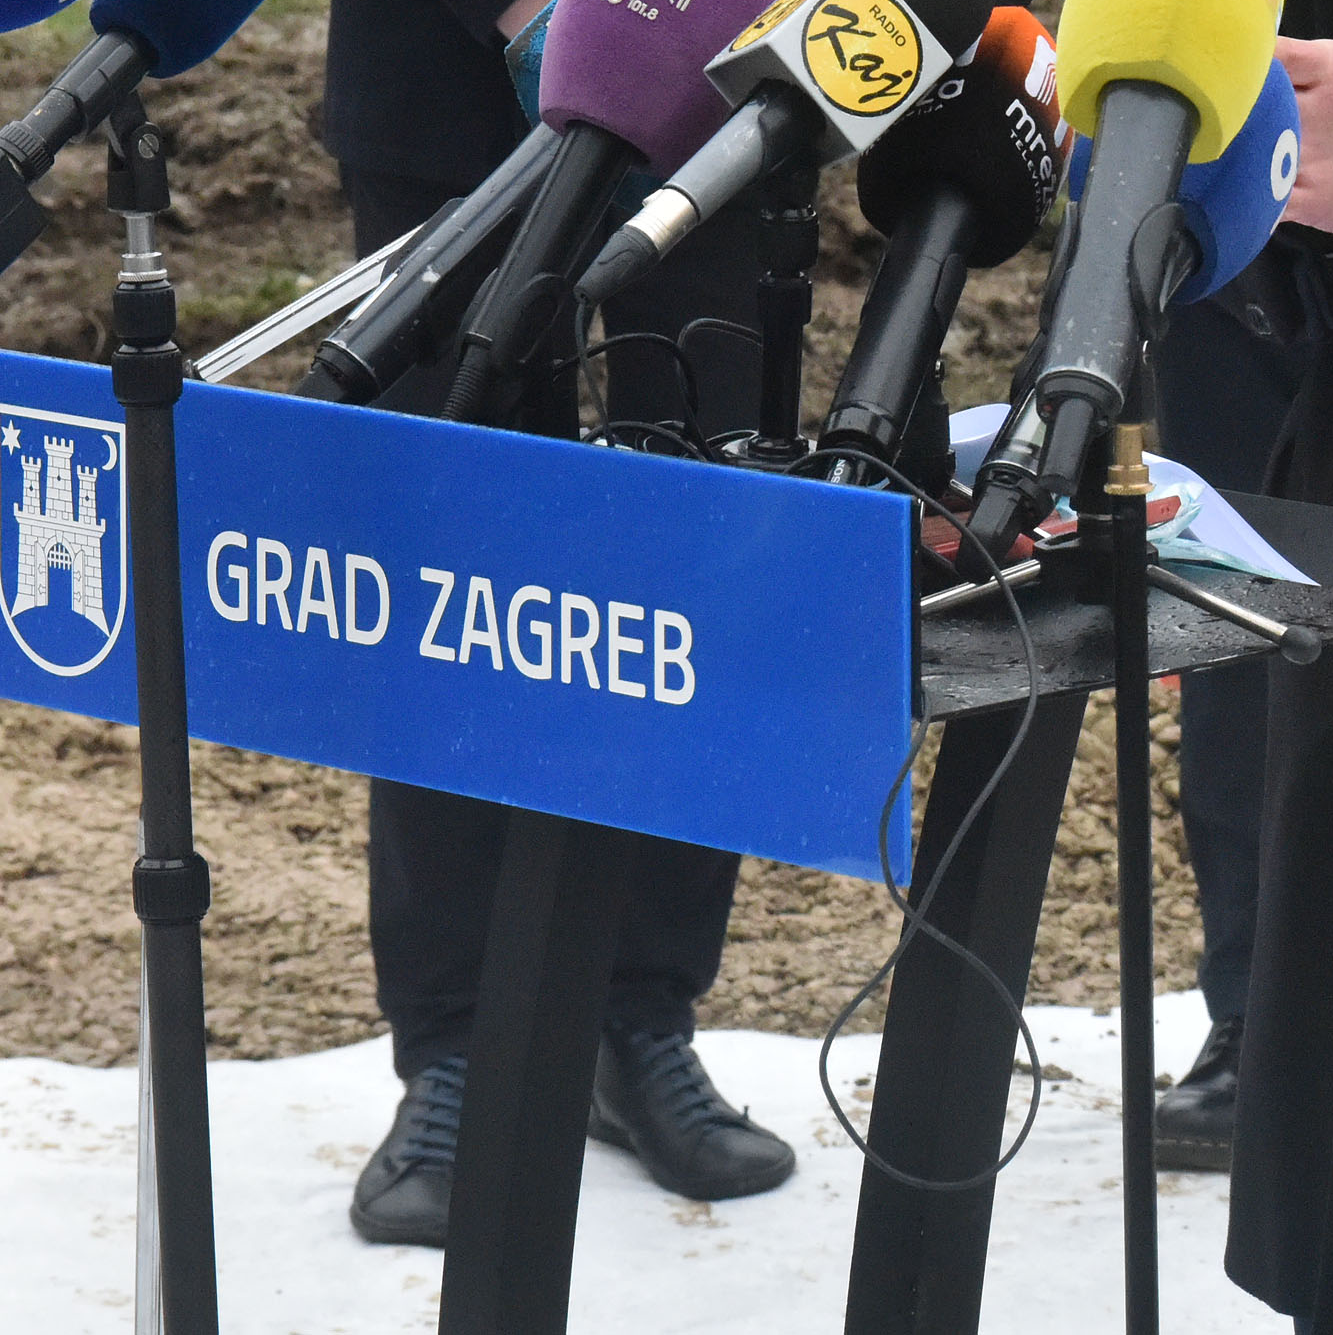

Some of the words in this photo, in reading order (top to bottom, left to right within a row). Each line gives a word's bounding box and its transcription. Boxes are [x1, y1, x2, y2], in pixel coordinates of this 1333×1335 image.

[808, 3, 913, 104] Kaj
[869, 4, 907, 48] RADIO
[830, 458, 847, 484] SON
[207, 531, 390, 645] GRAD
[419, 567, 697, 706] ZAGREB
